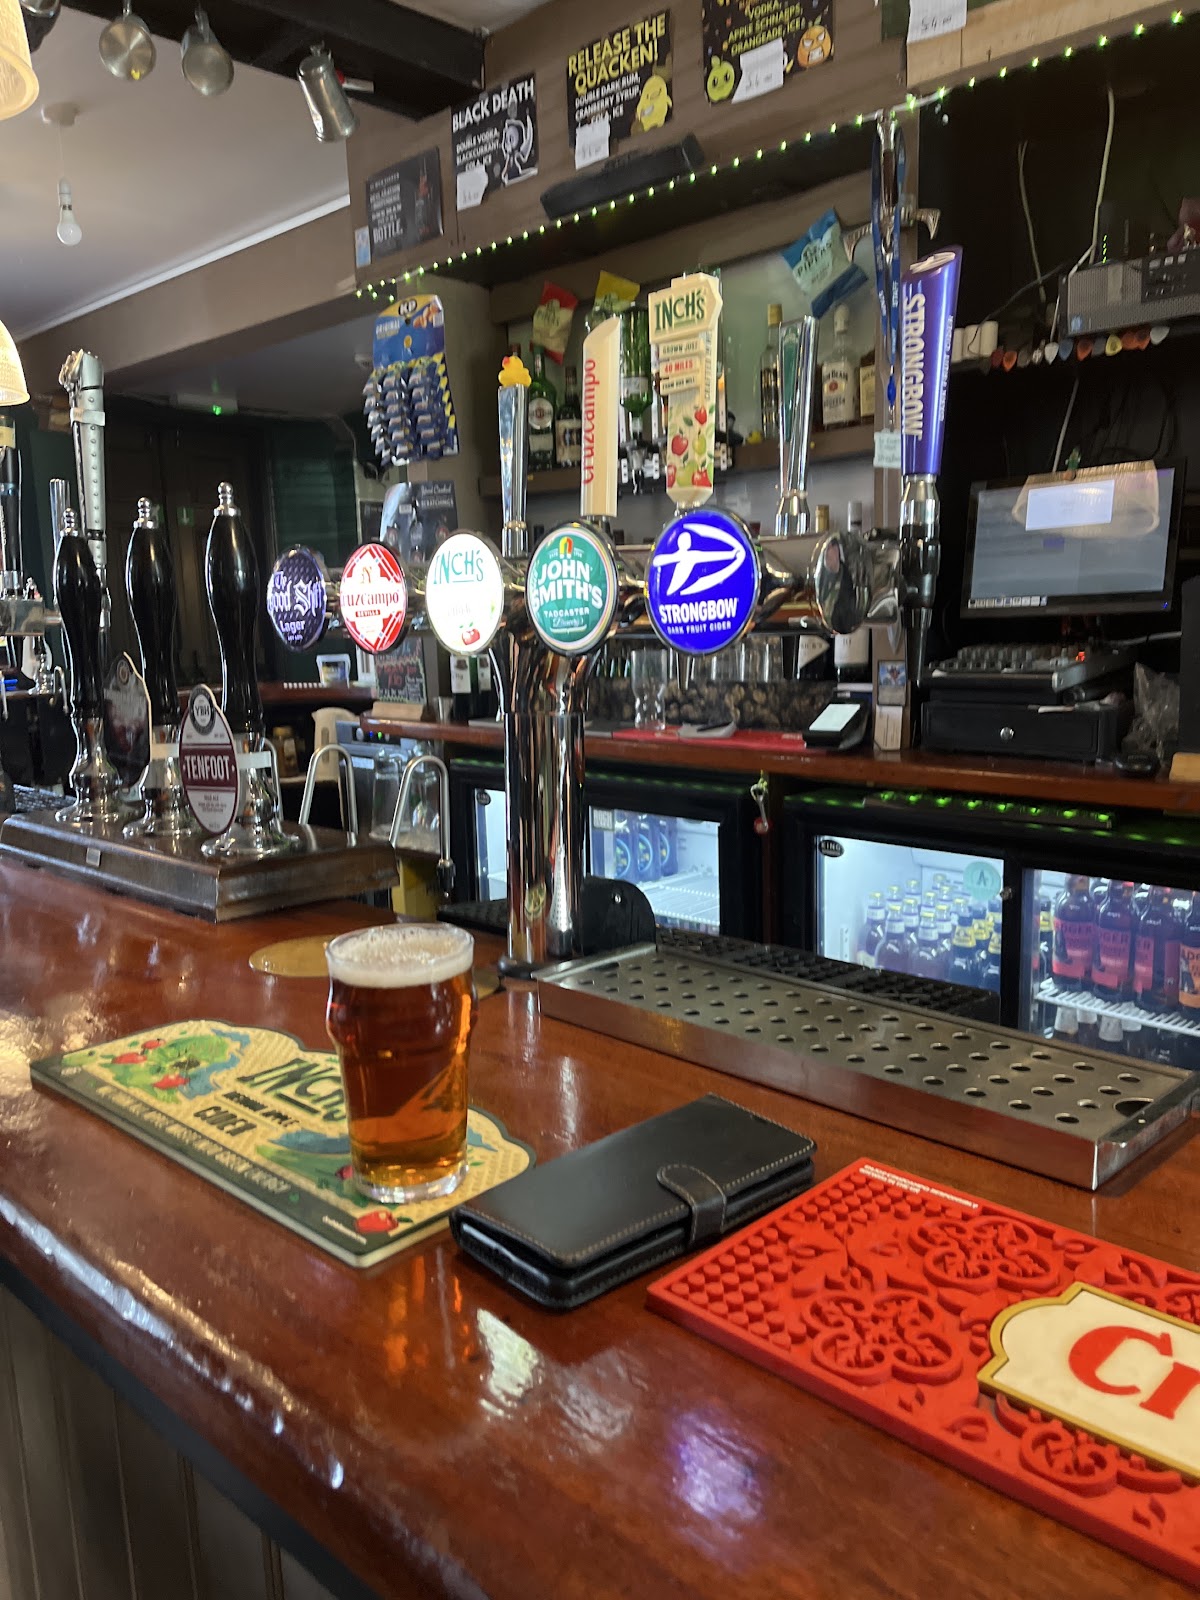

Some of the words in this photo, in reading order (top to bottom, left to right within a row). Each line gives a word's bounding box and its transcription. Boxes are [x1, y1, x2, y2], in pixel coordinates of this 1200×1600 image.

[568, 28, 631, 77] RELEASE
[633, 12, 666, 46] THE
[728, 21, 754, 44] APPLE
[575, 38, 658, 95] QUACKEN!
[452, 97, 491, 133] BLACK
[492, 77, 534, 114] DEATH
[575, 87, 601, 109] DOUBLE
[601, 78, 621, 96] DARK
[575, 95, 615, 122] CRANBERRY
[612, 103, 625, 119] ICE
[456, 134, 477, 156] DOUBLE
[400, 300, 417, 314] KP
[654, 289, 706, 332] INCH'S
[903, 293, 926, 441] STRONGBOW
[433, 549, 484, 585] INCH'S
[538, 559, 591, 586] JOHN
[531, 578, 603, 614] SMITH'S
[544, 606, 590, 618] TADCASTER
[659, 597, 738, 624] STRONGBOW
[280, 620, 305, 634] Lager
[667, 625, 685, 635] DARK
[686, 623, 707, 634] FRUIT
[709, 620, 732, 632] CIDER
[184, 755, 230, 781] TENFOOT
